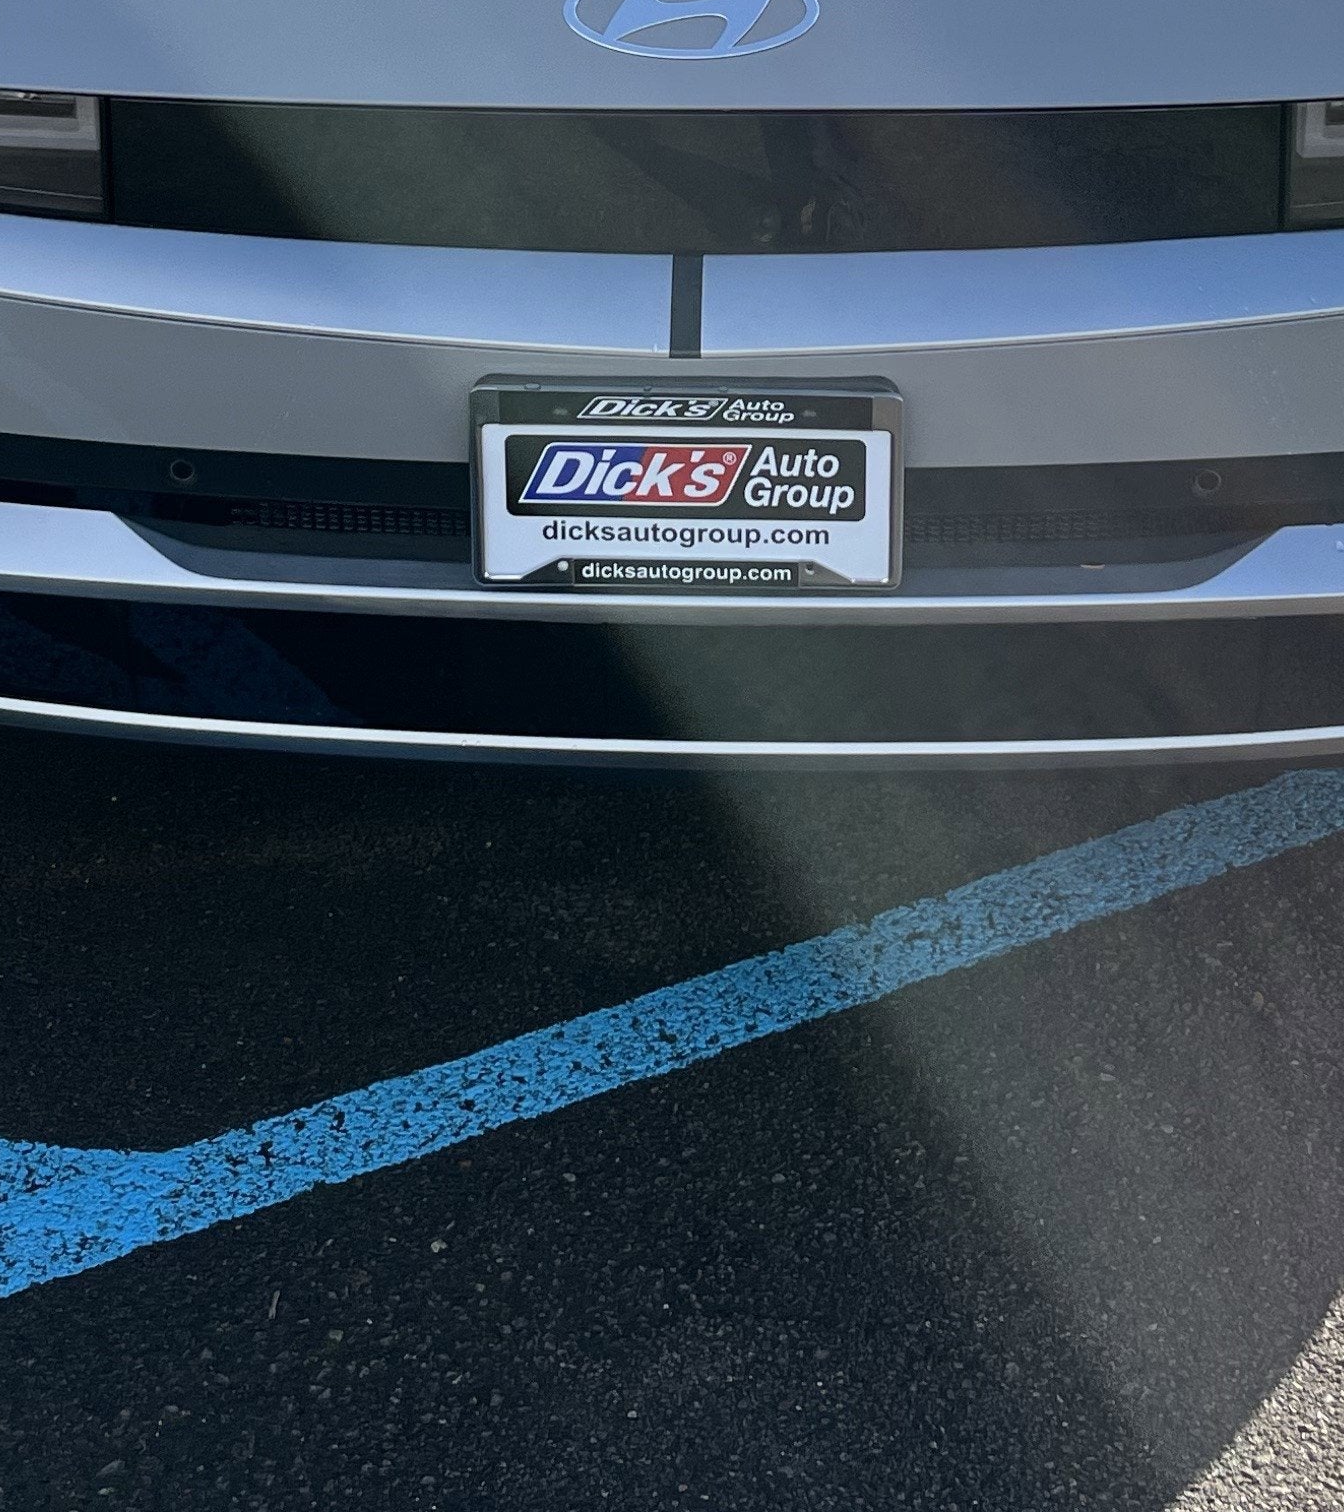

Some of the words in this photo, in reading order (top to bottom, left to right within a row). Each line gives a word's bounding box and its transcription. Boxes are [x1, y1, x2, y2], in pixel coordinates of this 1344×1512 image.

[589, 399, 710, 417] Dick's
[728, 398, 785, 411] Auto
[722, 409, 794, 424] Group
[750, 446, 839, 478] Auto
[743, 477, 855, 514] Group
[542, 520, 830, 548] dicksautogroup.com
[581, 561, 792, 584] dicksautogroup.com
